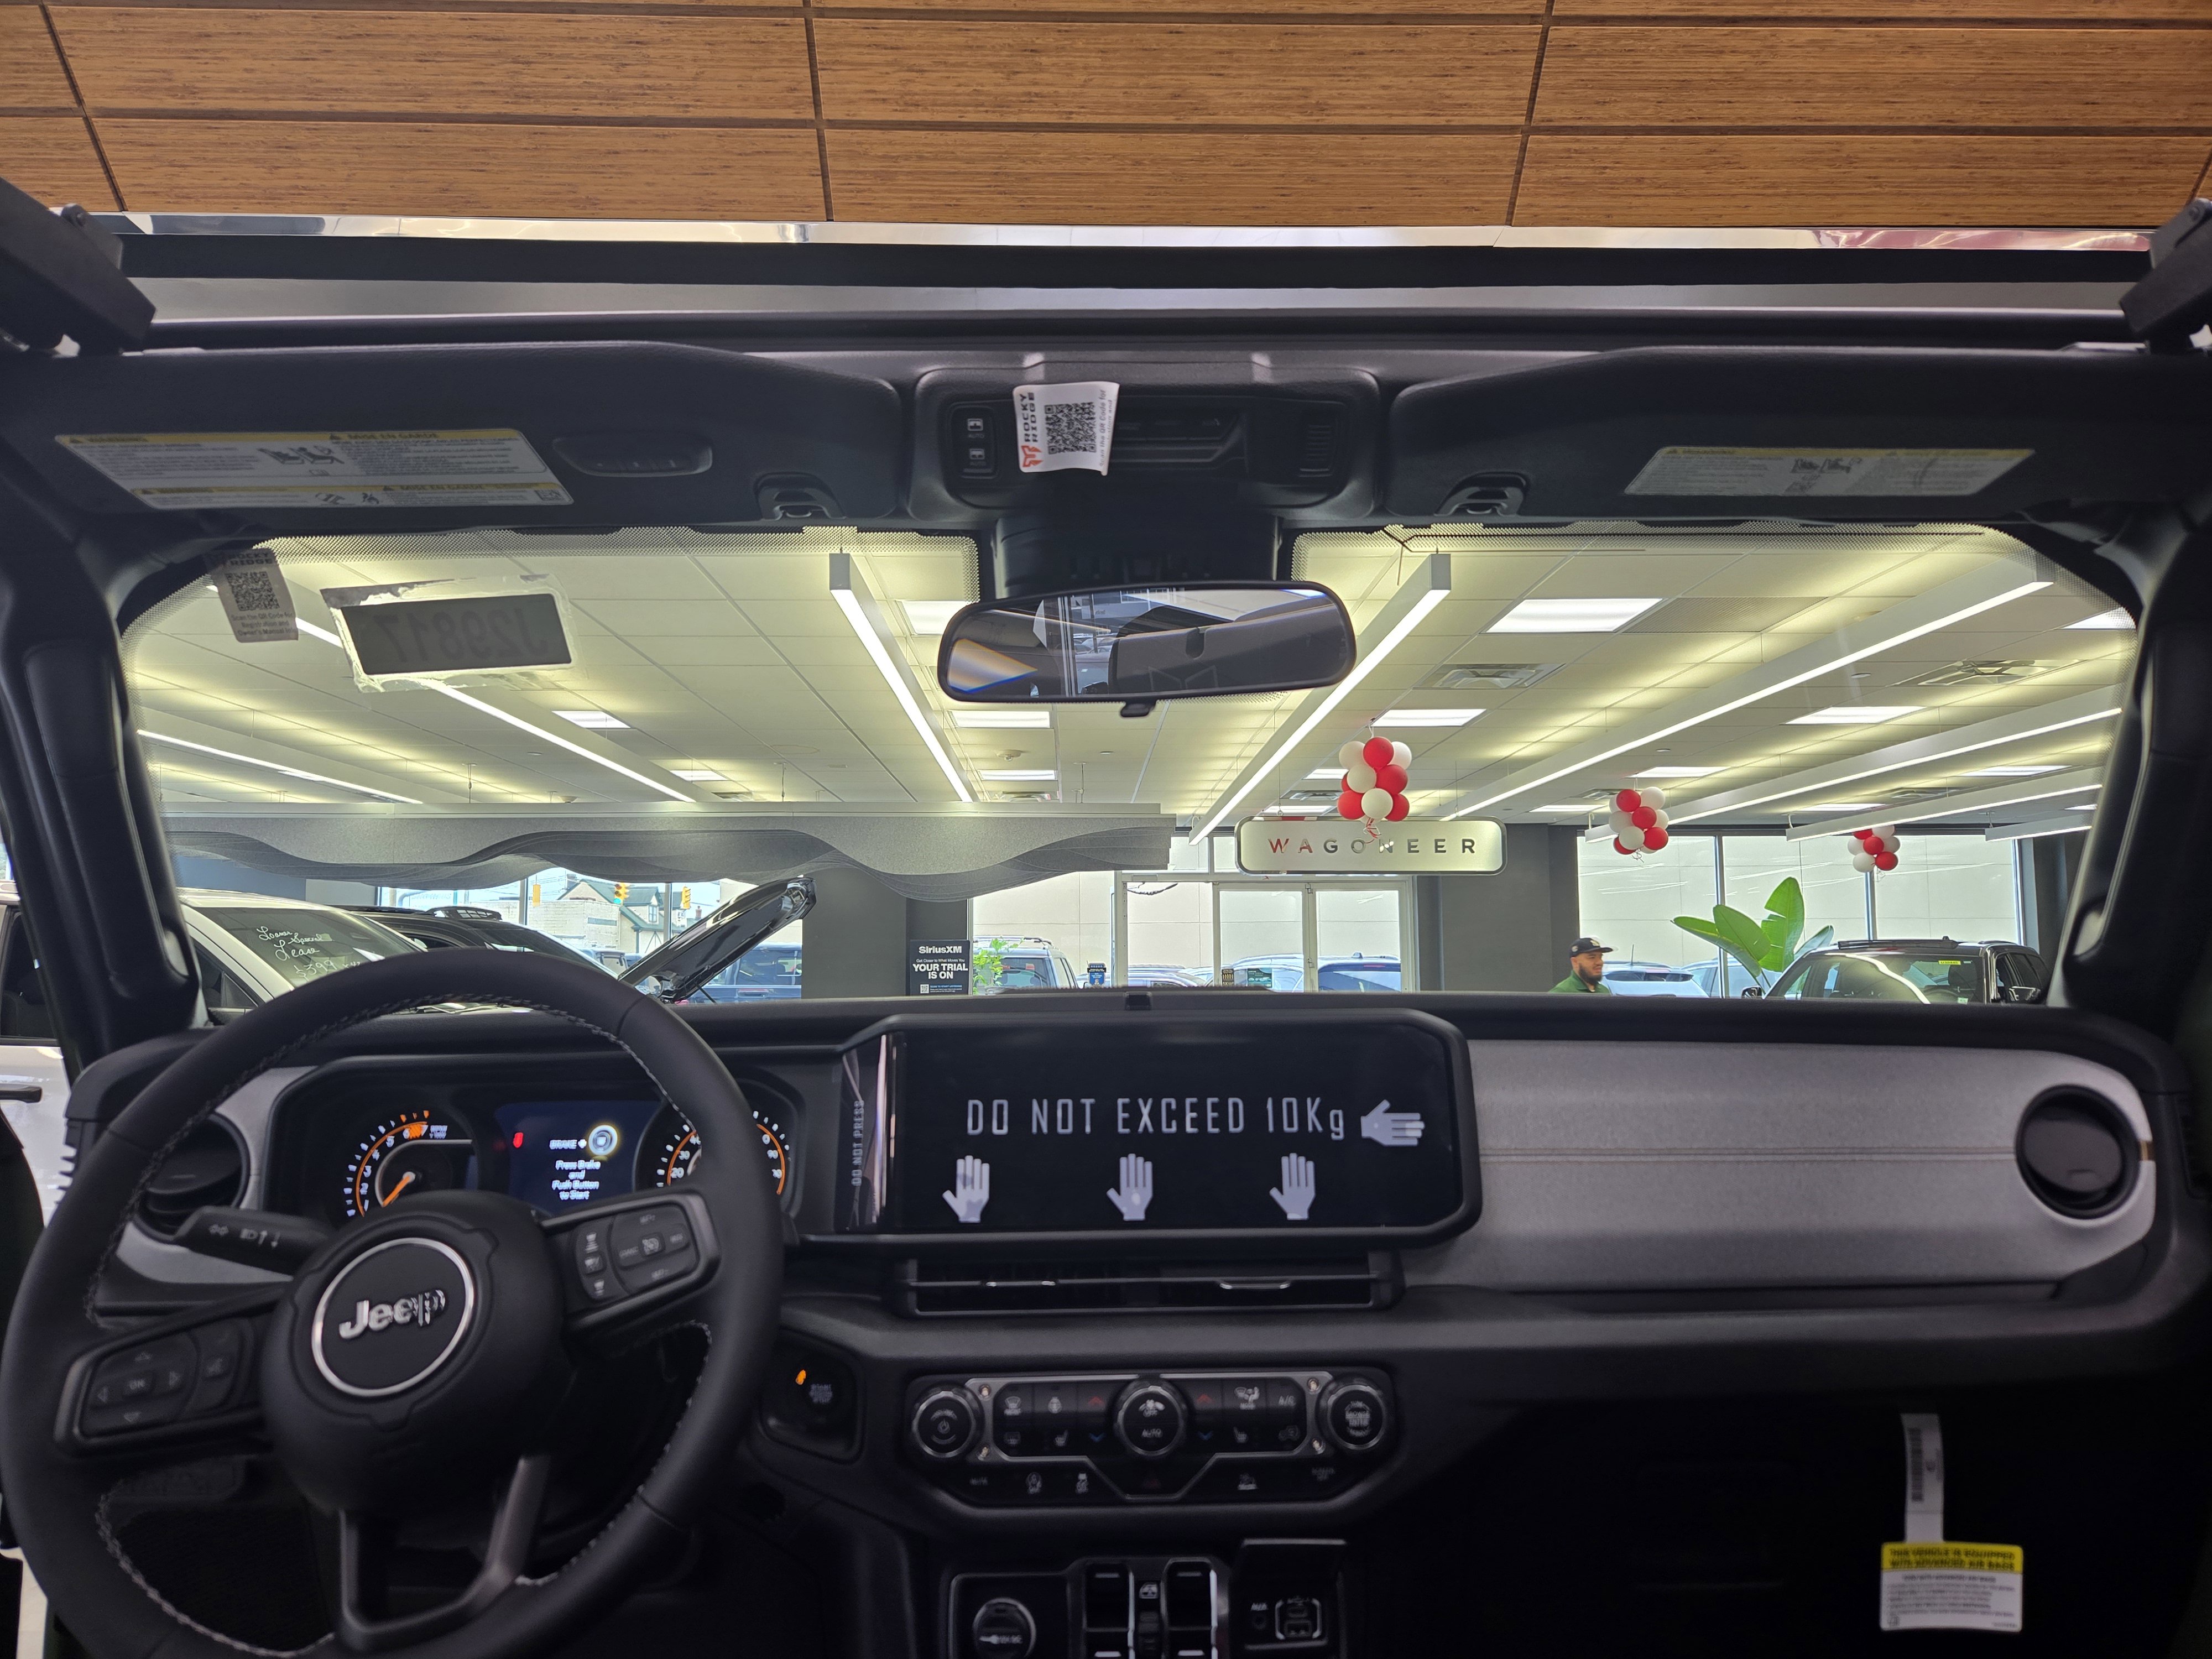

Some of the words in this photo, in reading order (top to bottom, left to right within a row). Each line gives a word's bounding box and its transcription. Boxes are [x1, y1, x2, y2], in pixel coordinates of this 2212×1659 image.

[1020, 393, 1030, 442] ROCKY
[1027, 392, 1038, 442] RIDGE
[1099, 424, 1106, 434] QR
[1268, 838, 1476, 854] WAGONEER
[256, 926, 293, 941] Loaner
[273, 940, 321, 961] Lease
[295, 959, 337, 982] $399
[853, 1100, 864, 1138] PRESS
[967, 1099, 1008, 1135] DO
[1032, 1098, 1095, 1135] NOT
[1117, 1098, 1244, 1134] EXCEED
[1266, 1097, 1344, 1141] 10Kg
[549, 1139, 577, 1150] BRAKE
[678, 1150, 690, 1160] 30
[852, 1142, 863, 1165] NOT
[363, 1165, 372, 1177] 3
[555, 1160, 577, 1170] Press
[577, 1160, 601, 1170] Brake
[568, 1170, 586, 1180] and
[670, 1167, 685, 1178] 20
[851, 1169, 862, 1187] DO
[360, 1182, 369, 1195] 2
[551, 1180, 571, 1190] Push
[572, 1180, 599, 1190] Button
[559, 1191, 570, 1200] to
[570, 1190, 590, 1200] Start
[338, 1289, 446, 1340] Jeep
[1278, 1395, 1296, 1406] A/C
[1141, 1428, 1162, 1438] AUTO
[1964, 1549, 2015, 1559] EQUIPPED
